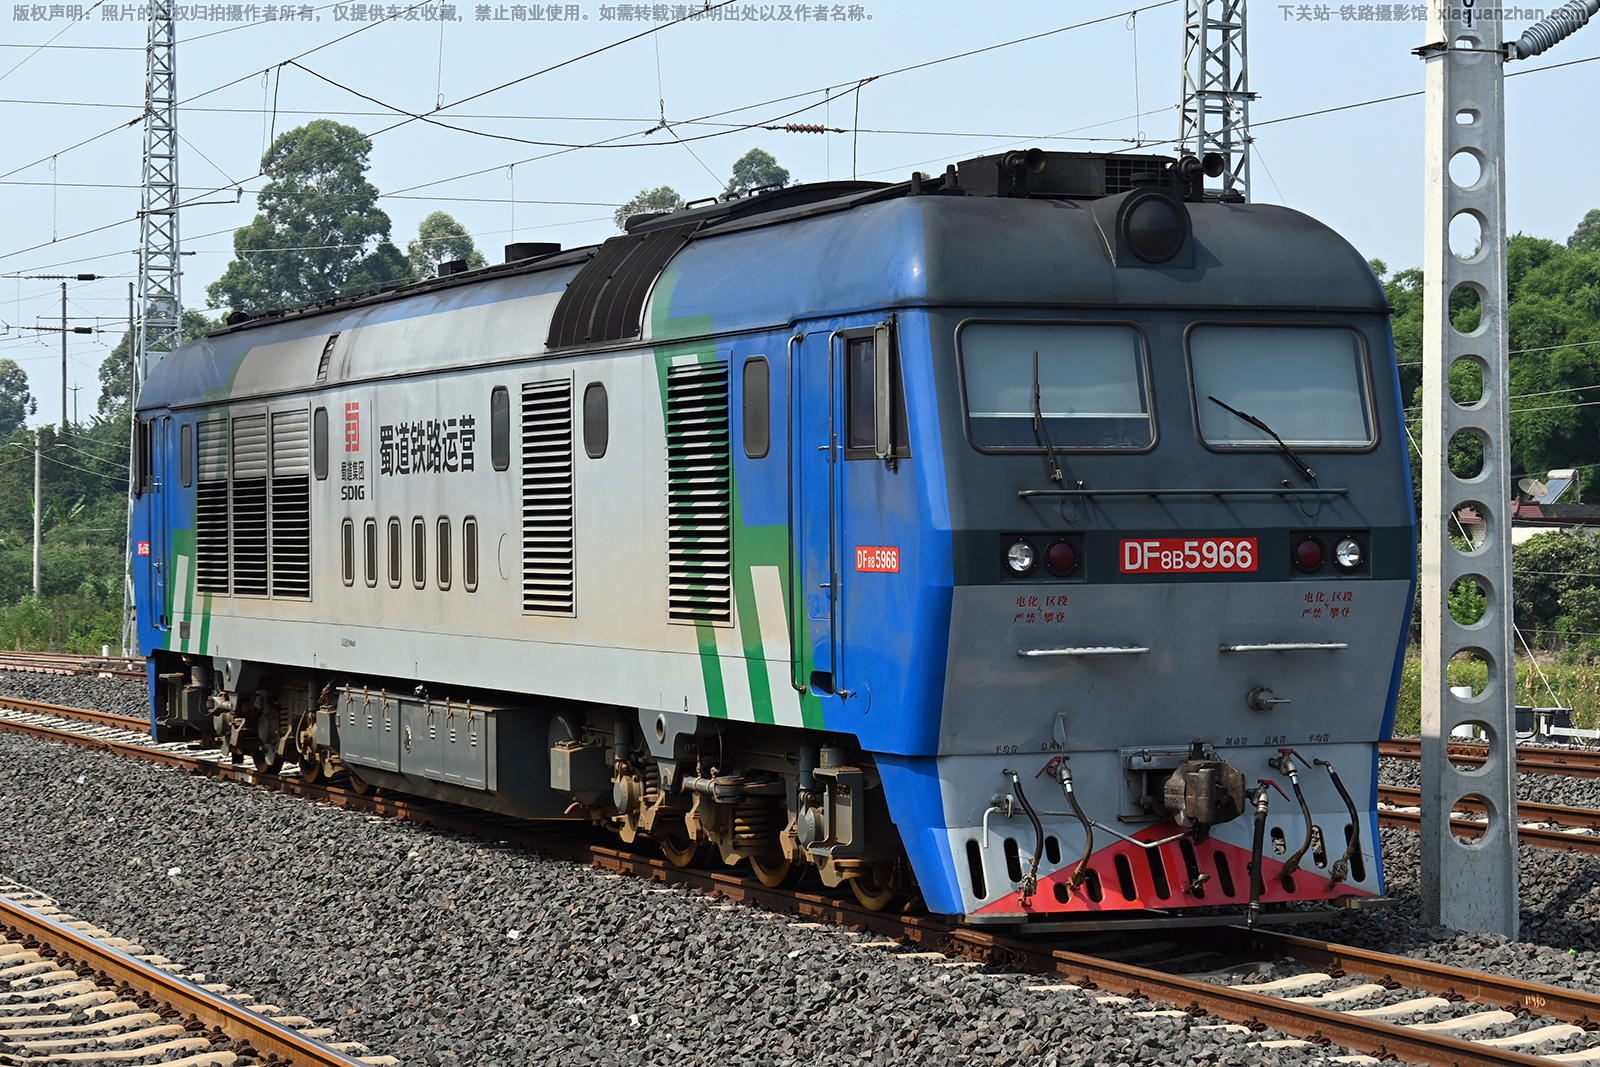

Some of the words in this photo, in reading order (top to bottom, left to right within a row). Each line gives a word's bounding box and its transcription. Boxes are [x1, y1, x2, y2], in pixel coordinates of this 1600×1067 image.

[379, 414, 476, 477] 蜀道铁路运营
[341, 460, 365, 481] 蜀道集团
[341, 485, 365, 501] SDIG
